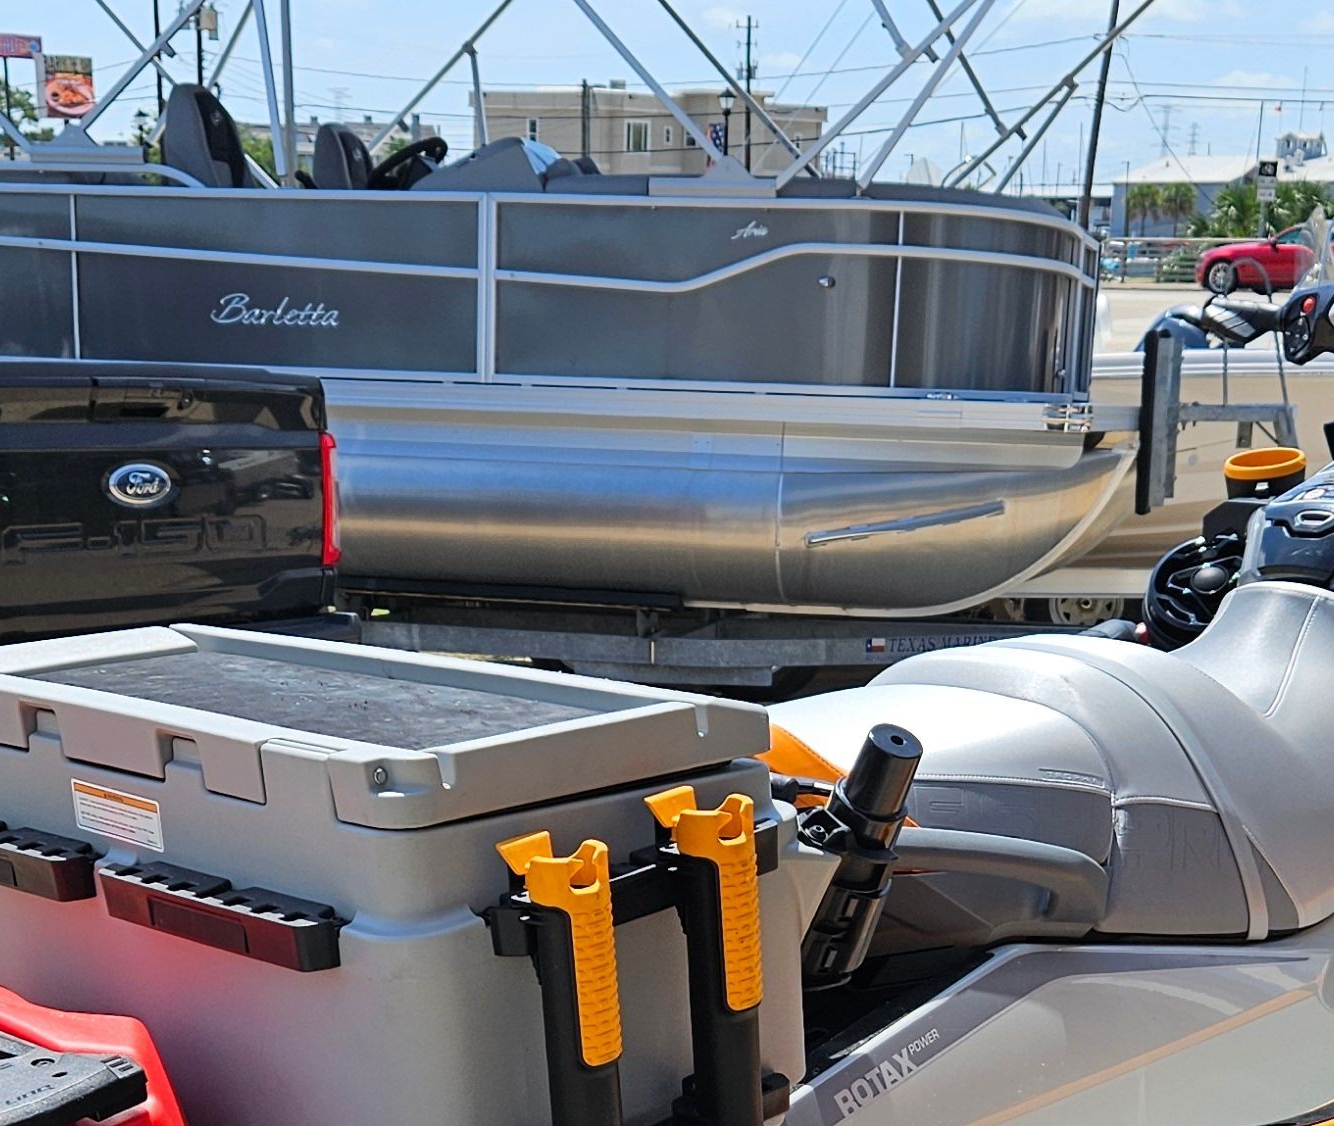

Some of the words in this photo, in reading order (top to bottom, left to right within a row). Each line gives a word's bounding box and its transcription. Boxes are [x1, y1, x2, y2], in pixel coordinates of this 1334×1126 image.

[210, 292, 340, 326] Barletta
[126, 471, 159, 495] Ford
[889, 637, 936, 652] TEXAS
[833, 1047, 918, 1118] ROTAX
[907, 1028, 940, 1056] POWER
